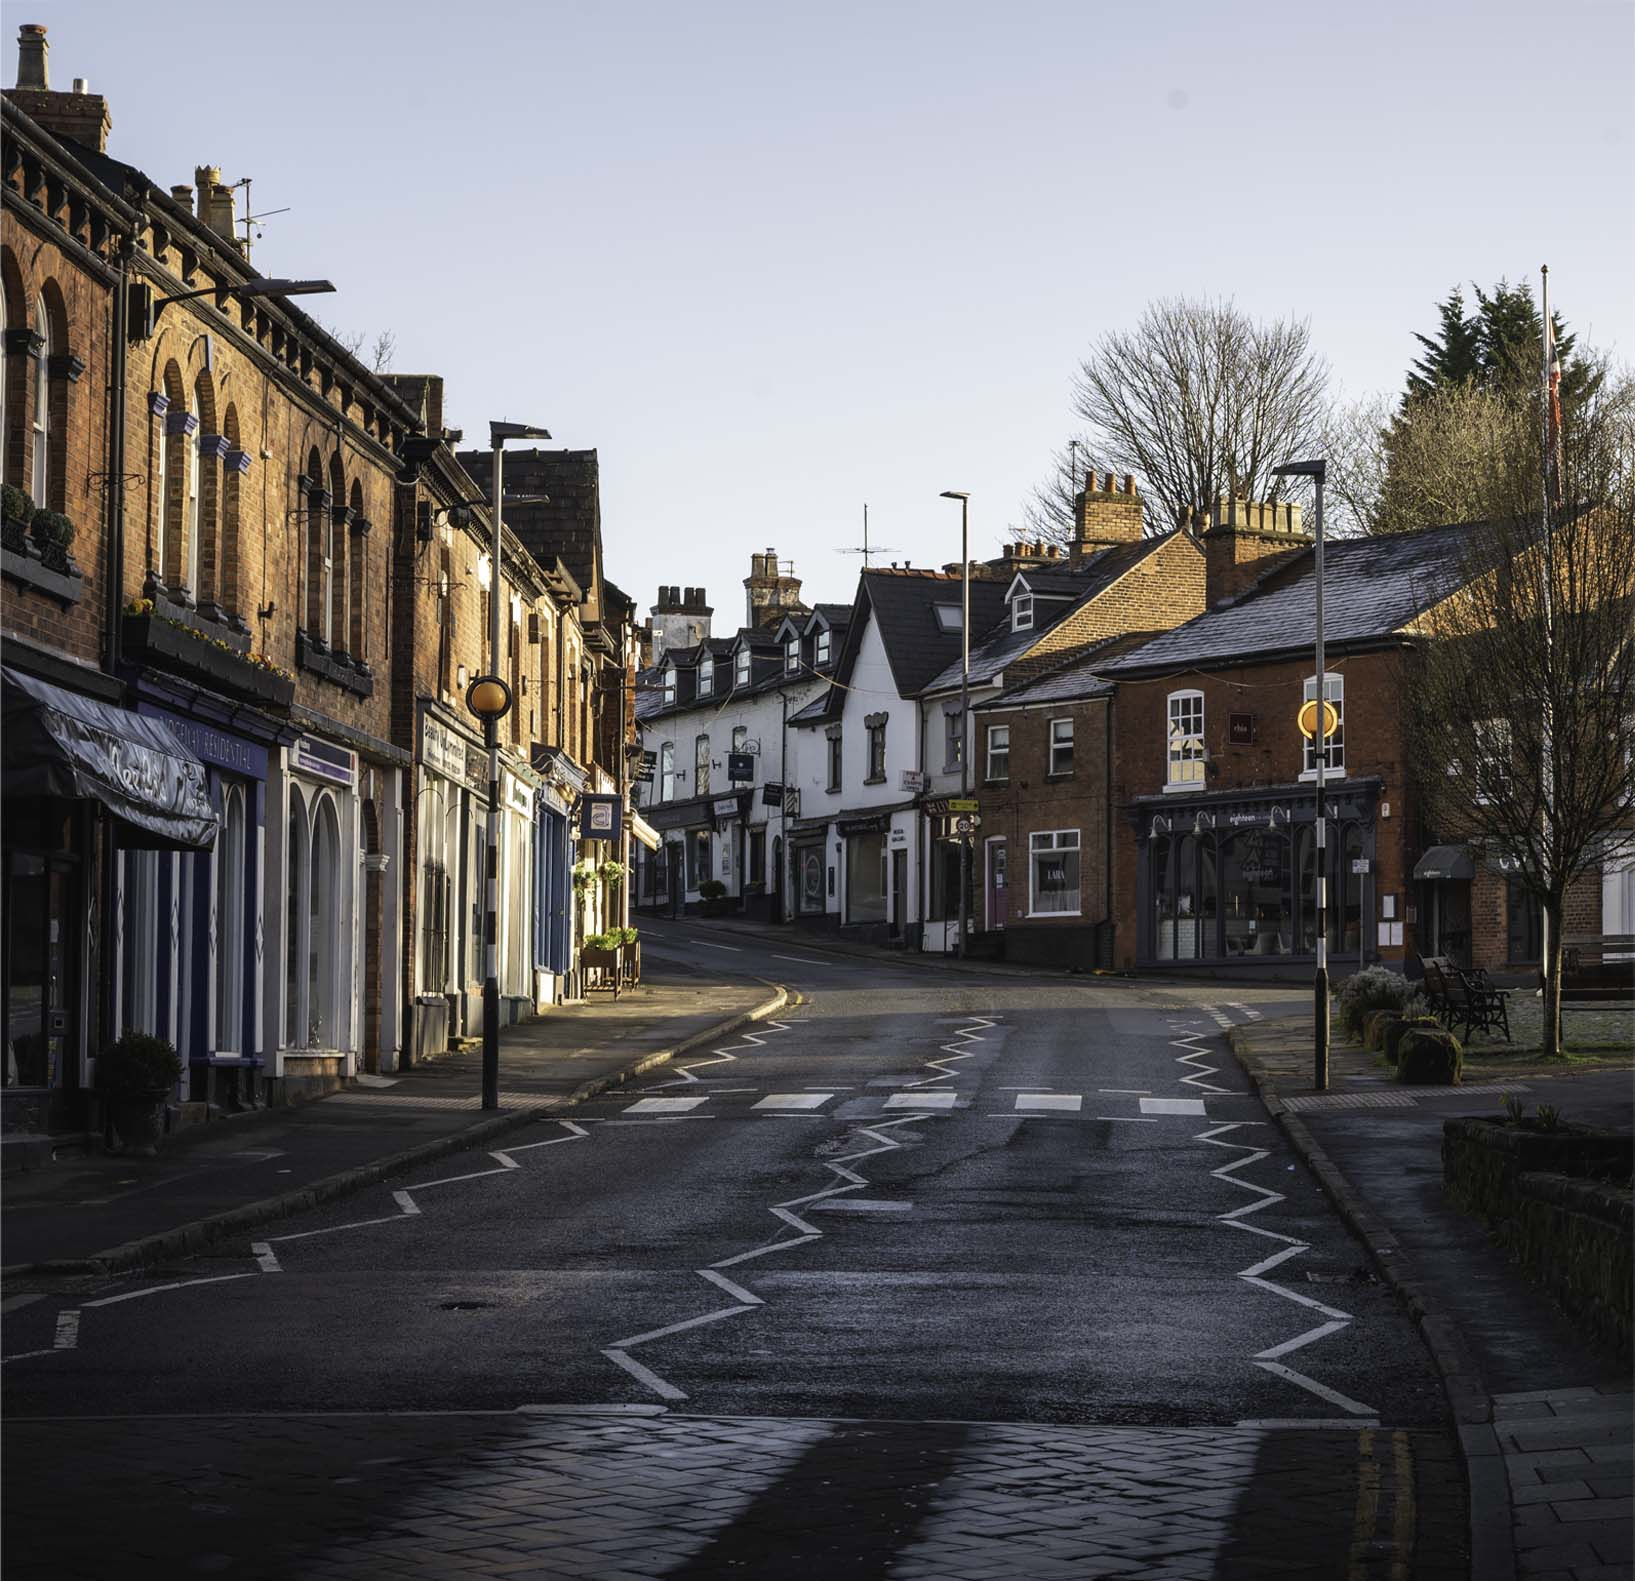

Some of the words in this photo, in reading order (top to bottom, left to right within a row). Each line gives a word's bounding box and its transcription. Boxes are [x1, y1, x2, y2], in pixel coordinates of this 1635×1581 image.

[203, 731, 252, 770] RESIDENTIAL
[1229, 812, 1256, 826] eighteen
[958, 822, 970, 831] 20
